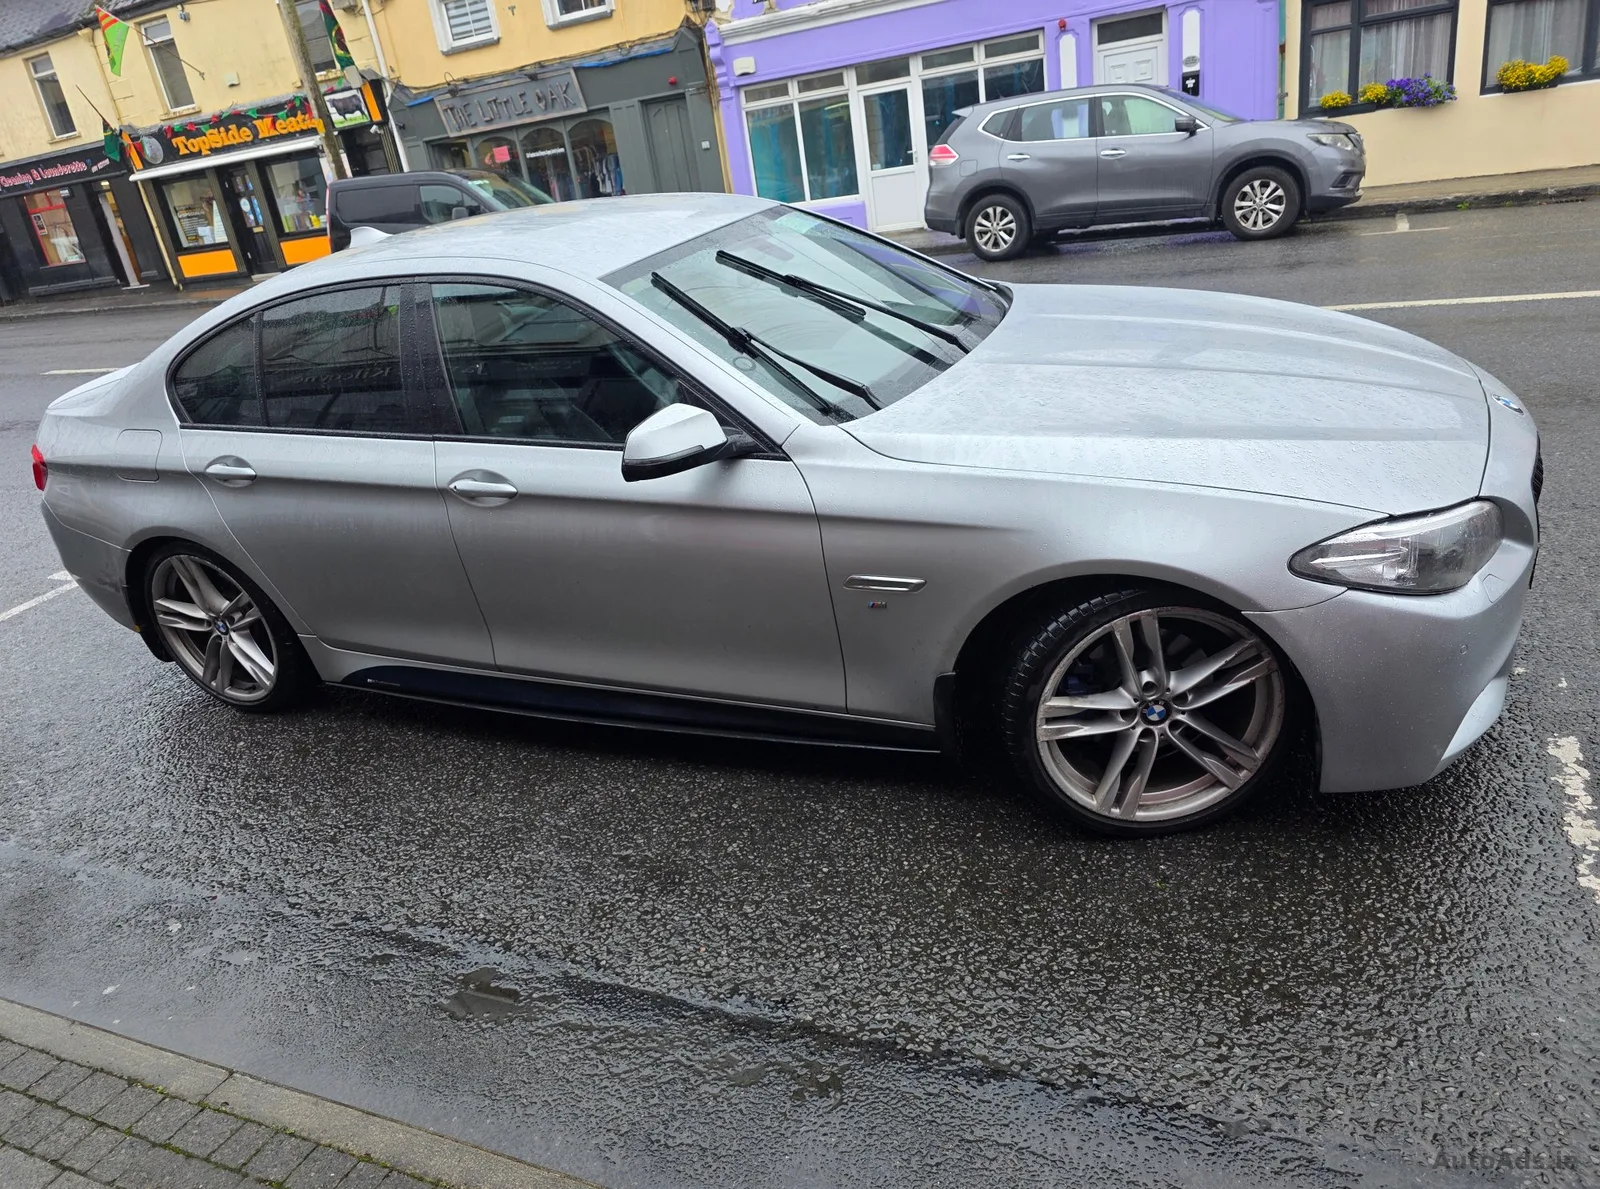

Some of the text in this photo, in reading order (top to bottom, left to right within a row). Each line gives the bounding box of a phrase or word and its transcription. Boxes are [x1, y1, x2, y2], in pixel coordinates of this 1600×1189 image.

[443, 81, 576, 132] THE LITTLE OAK
[171, 124, 253, 156] TopSide
[30, 168, 41, 180] &
